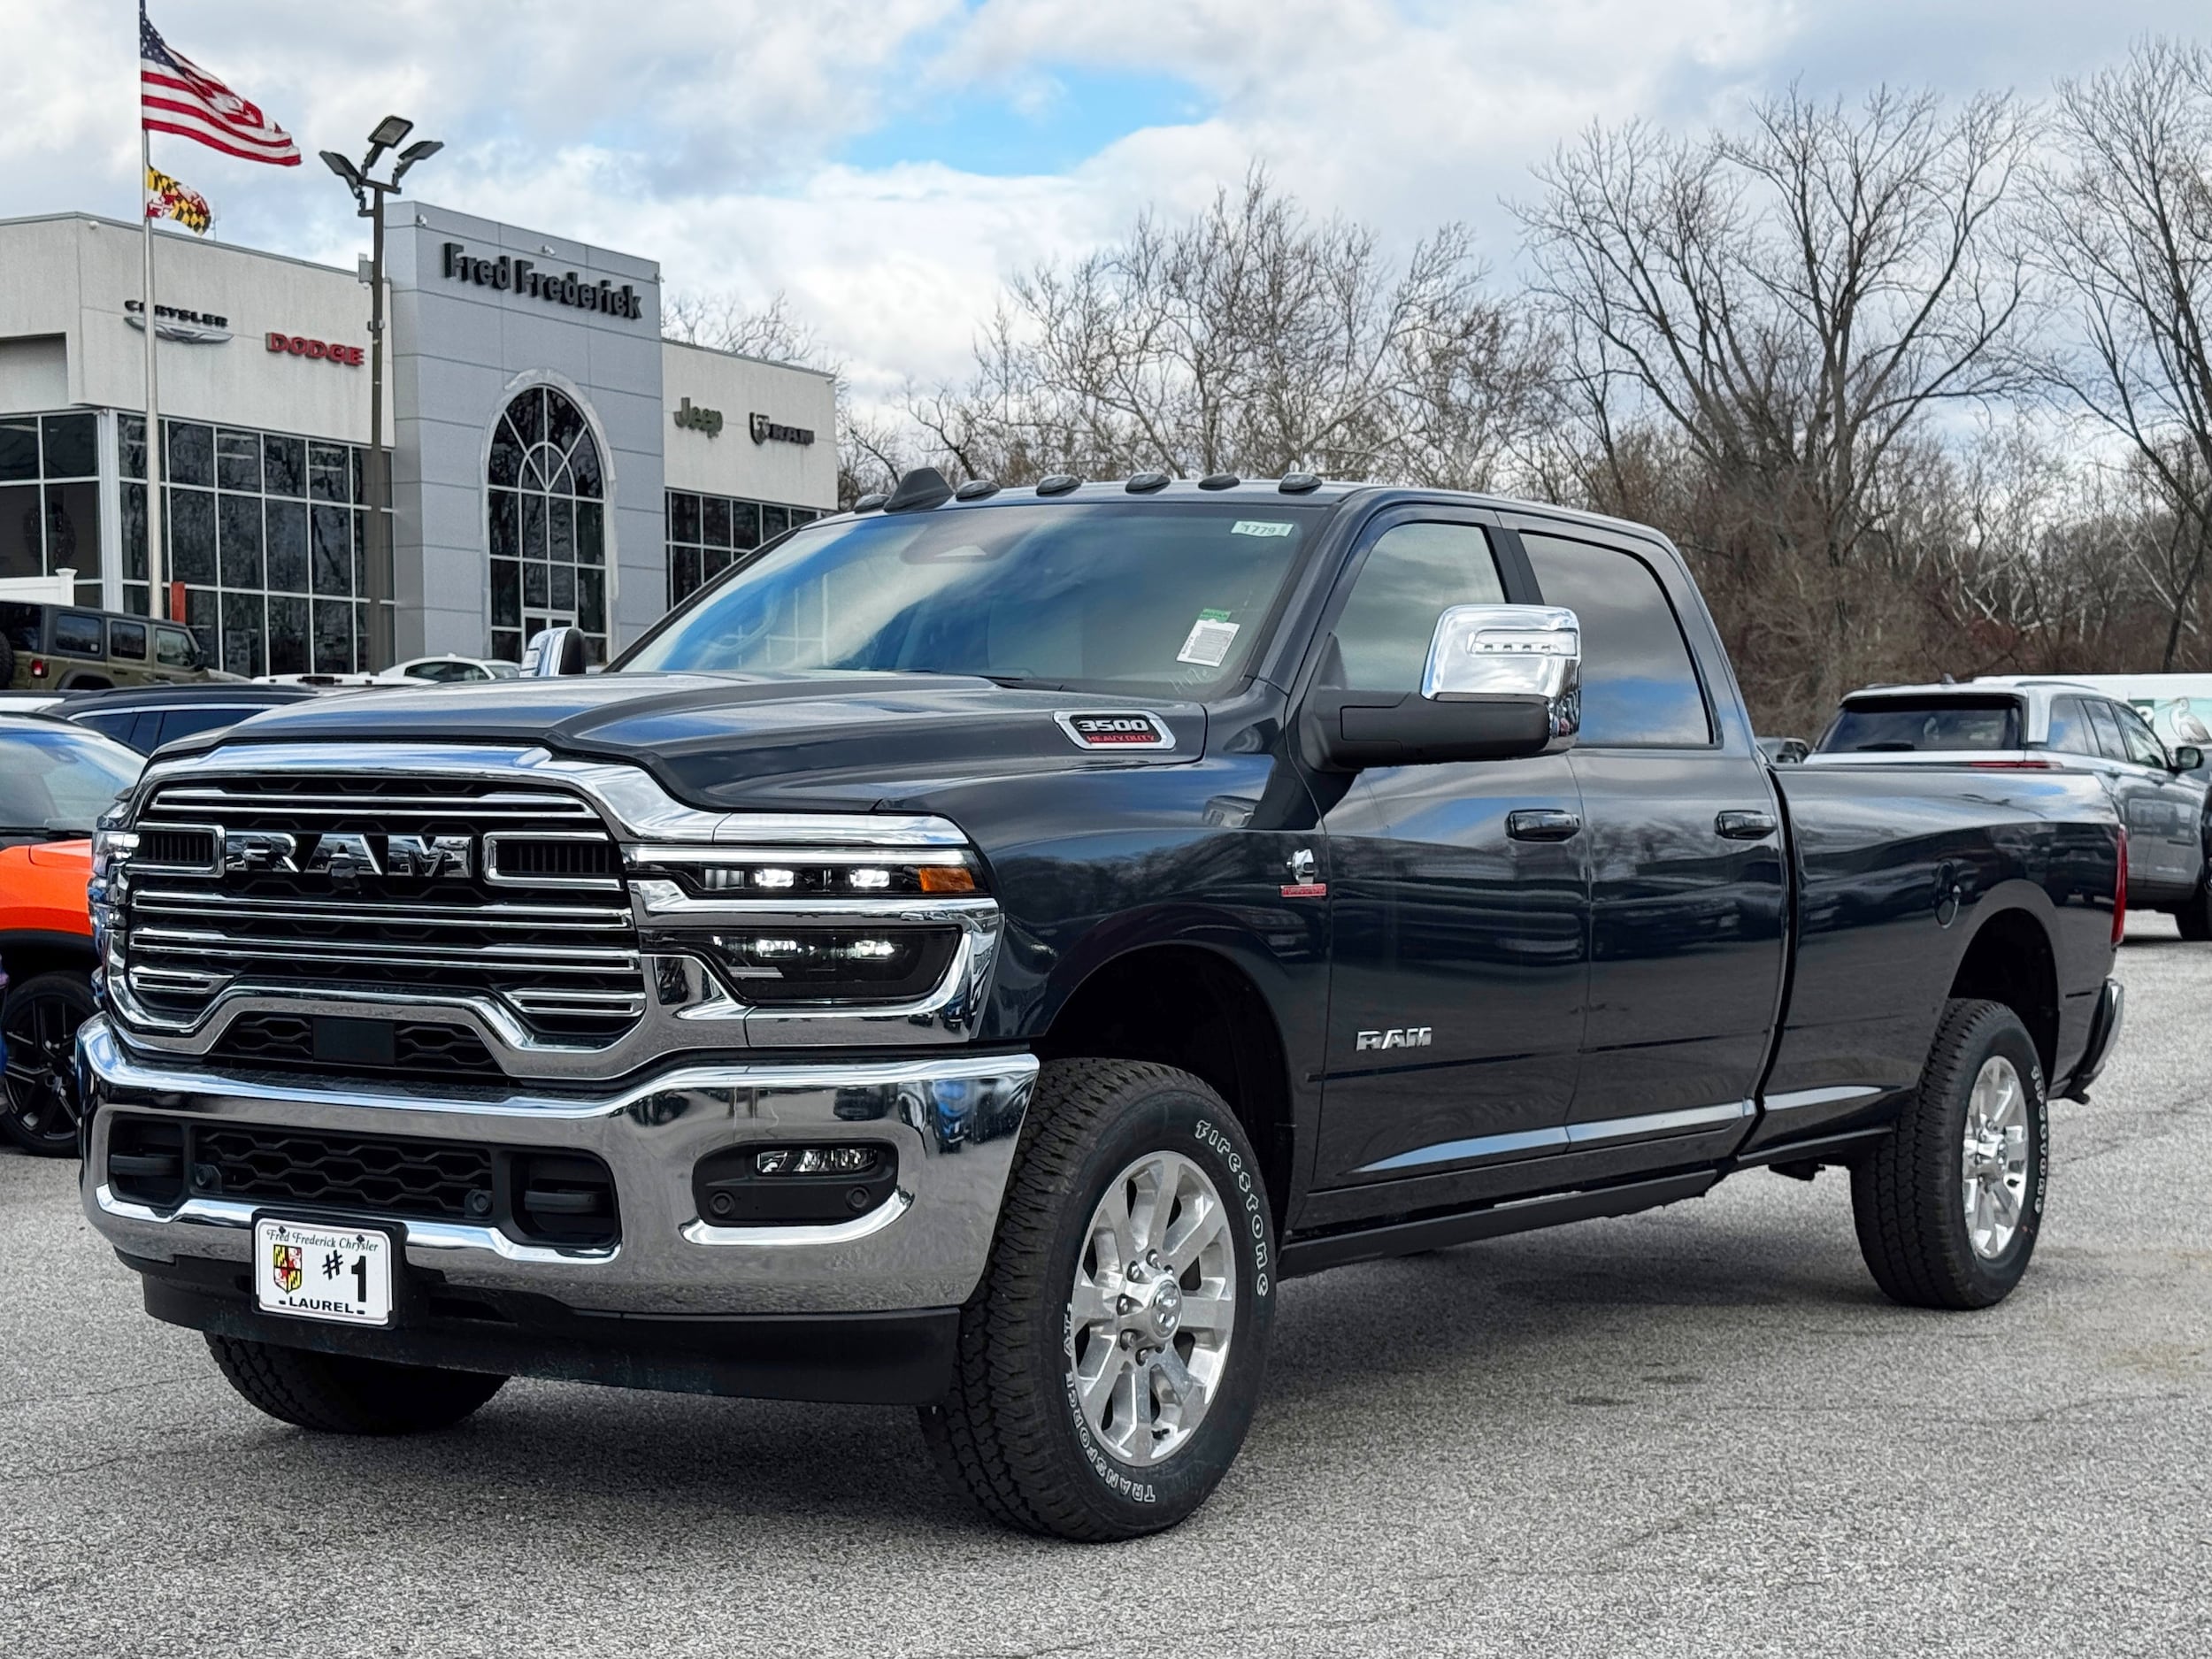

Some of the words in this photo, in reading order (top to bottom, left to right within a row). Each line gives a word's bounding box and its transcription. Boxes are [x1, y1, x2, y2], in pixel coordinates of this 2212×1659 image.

[443, 242, 511, 290] Fred
[515, 259, 642, 319] Frederick
[265, 332, 365, 366] DODGE
[673, 397, 723, 439] Jeep
[768, 423, 815, 446] RAM
[1077, 719, 1149, 732] 3500
[225, 830, 472, 878] RAM
[1356, 1027, 1432, 1051] RAM
[1195, 1119, 1269, 1297] Firestone
[266, 1228, 290, 1242] Fred
[292, 1232, 337, 1248] Frederick
[339, 1237, 379, 1252] Chrysler
[289, 1296, 354, 1314] LAUREL
[1065, 1371, 1156, 1503] TRANSFORCE
